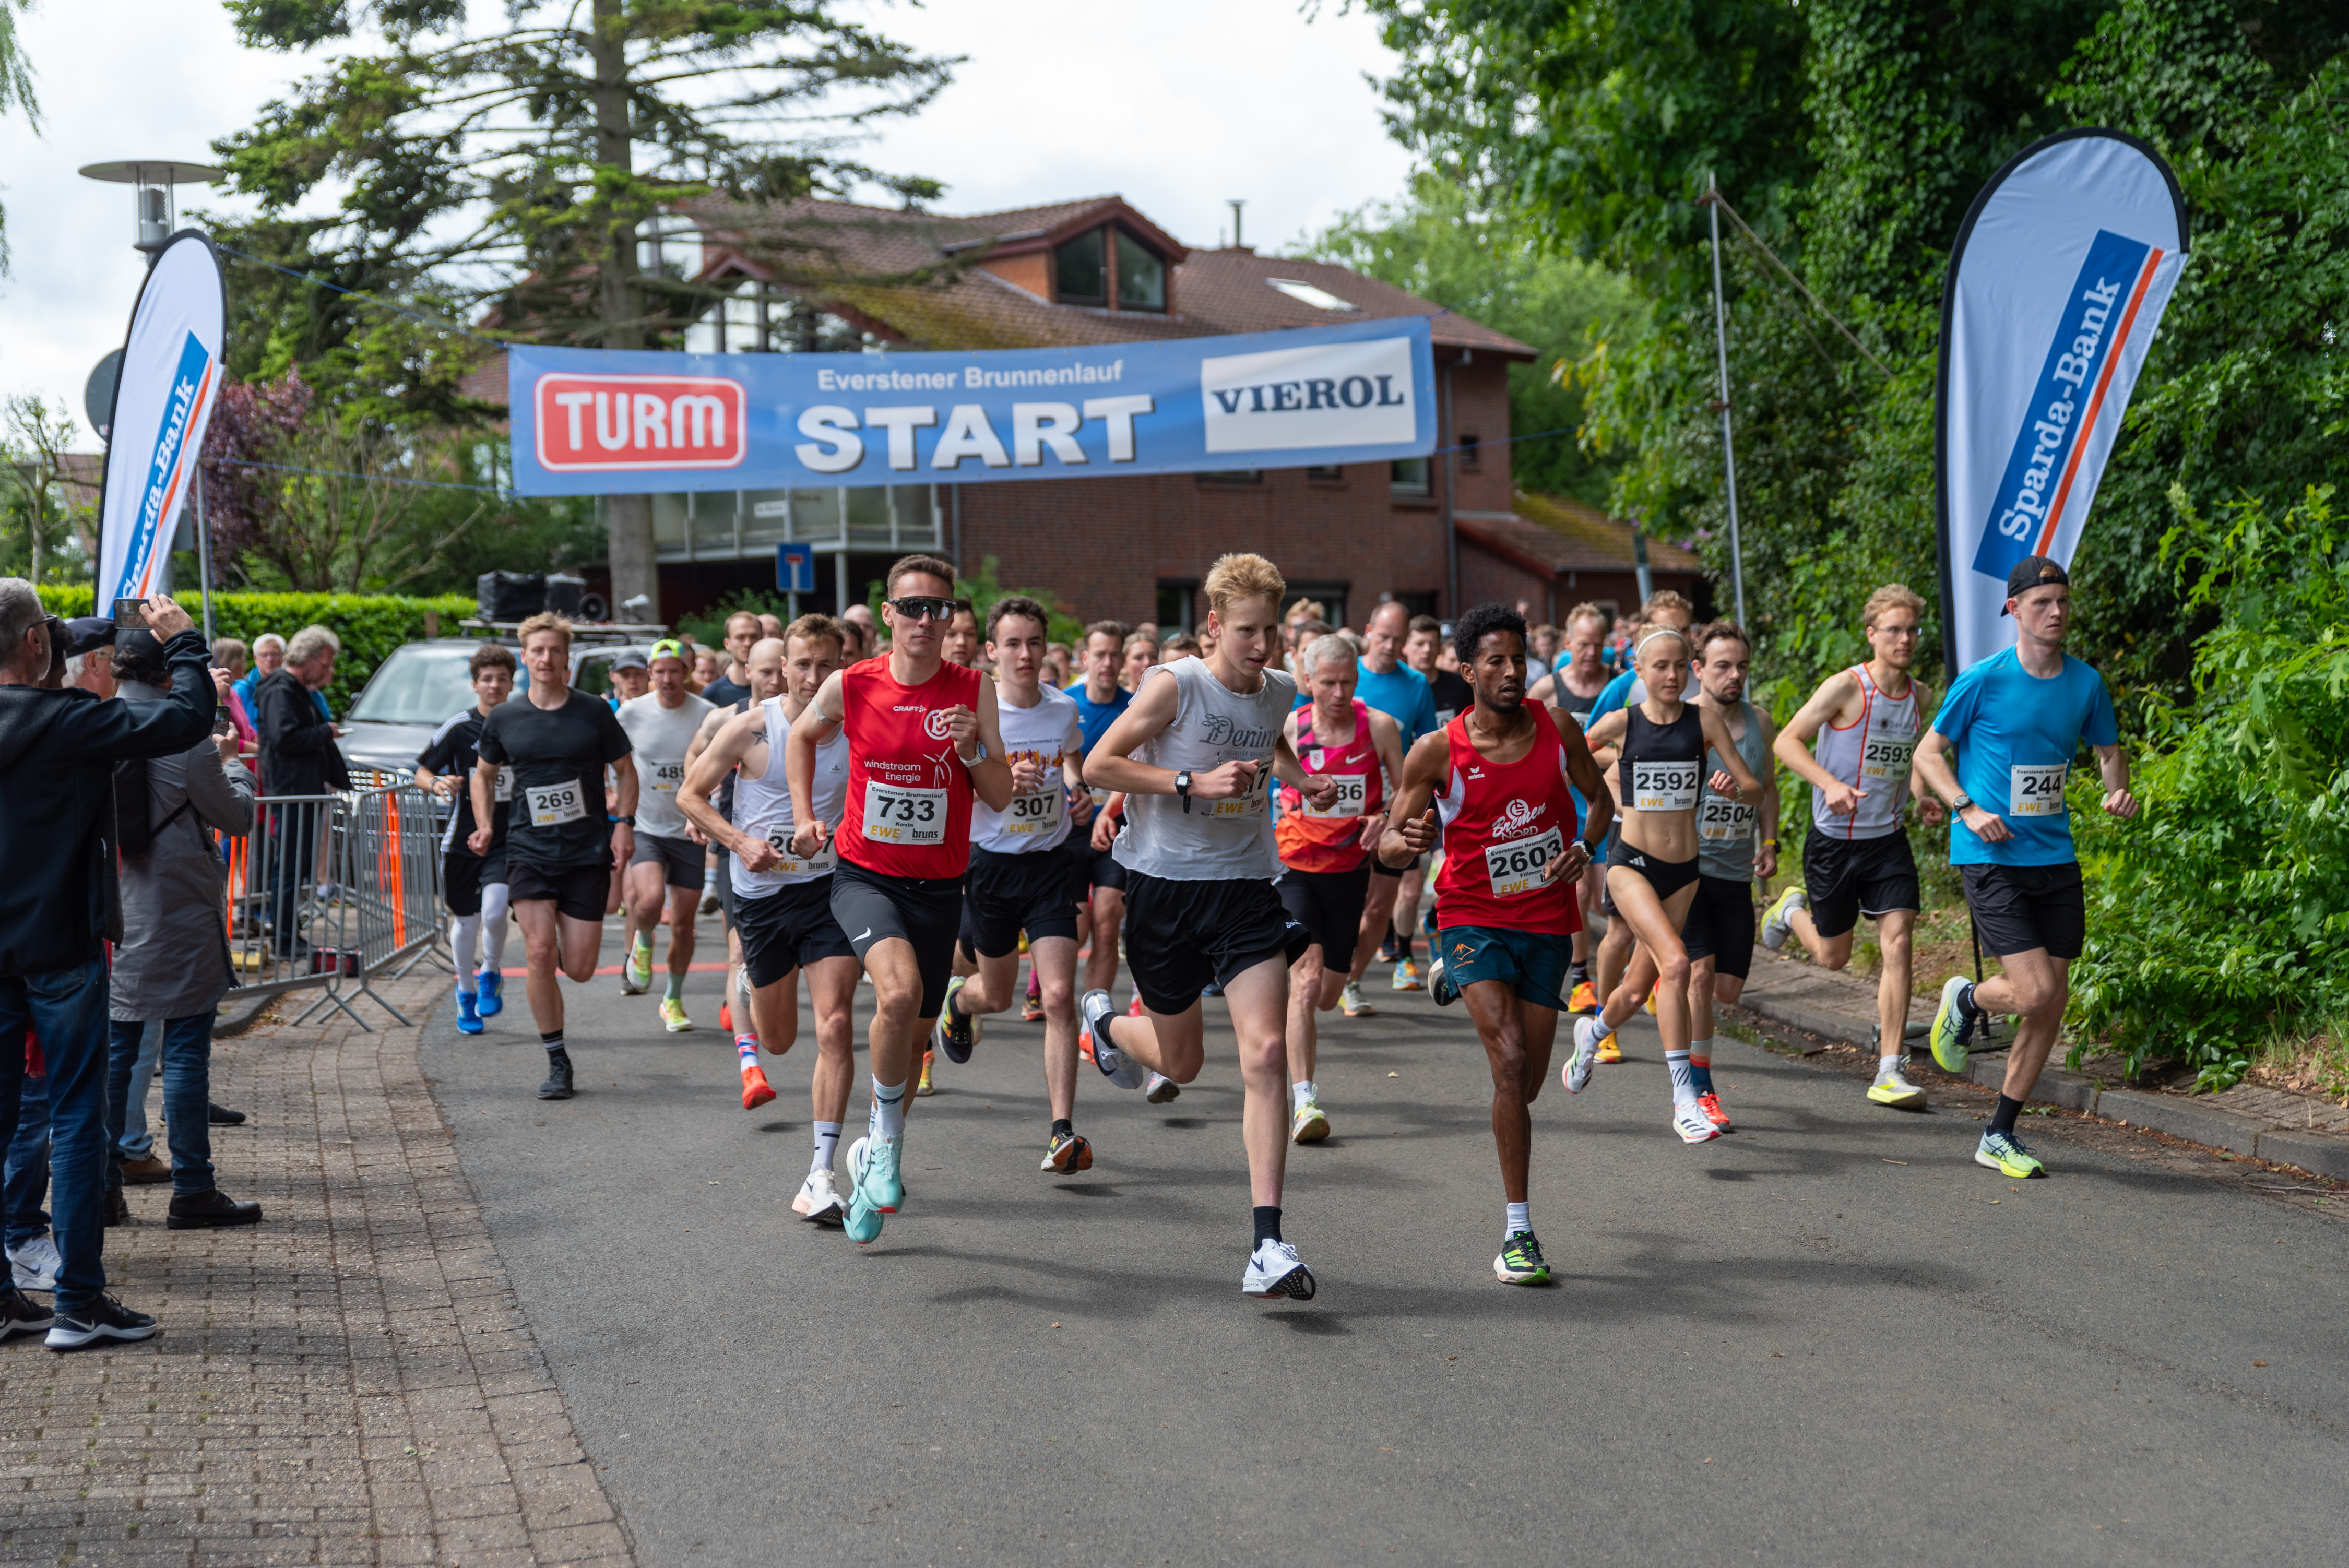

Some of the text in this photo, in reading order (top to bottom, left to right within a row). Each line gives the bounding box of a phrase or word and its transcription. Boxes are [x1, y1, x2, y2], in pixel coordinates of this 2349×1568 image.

[817, 359, 1124, 391] Everstener Brunnenlauf
[1211, 374, 1404, 414] VIEROL
[1998, 276, 2121, 542] Sparda-Bank
[555, 391, 726, 451] TURM
[794, 393, 1155, 473] START
[1199, 714, 1276, 748] Denim
[1865, 744, 1912, 763] 2593
[864, 760, 921, 771] windstream
[1866, 766, 1887, 776] EWE
[885, 772, 921, 783] Energie
[1636, 771, 1696, 791] 2592
[2022, 774, 2061, 795] 244
[536, 791, 574, 810] 269
[872, 786, 905, 797] Everstener
[877, 795, 934, 822] 733
[1013, 794, 1054, 817] 307
[1217, 802, 1245, 813] EWE
[1640, 797, 1693, 806] EWE bruns
[2017, 802, 2042, 812] EWE
[537, 813, 556, 823] EWE
[1492, 802, 1546, 838] Bremen
[1704, 805, 1754, 823] 2504
[870, 824, 938, 839] EWE bruns
[1010, 819, 1057, 833] EWE bruns
[1501, 825, 1539, 841] NORD
[1706, 828, 1727, 836] EWE
[768, 835, 835, 855] 267
[1490, 831, 1557, 856] Everstener Brunnenlauf
[808, 861, 829, 870] bruns
[1490, 839, 1562, 879] 2603
[1520, 869, 1542, 878] Filimon
[1501, 878, 1529, 895] EWE
